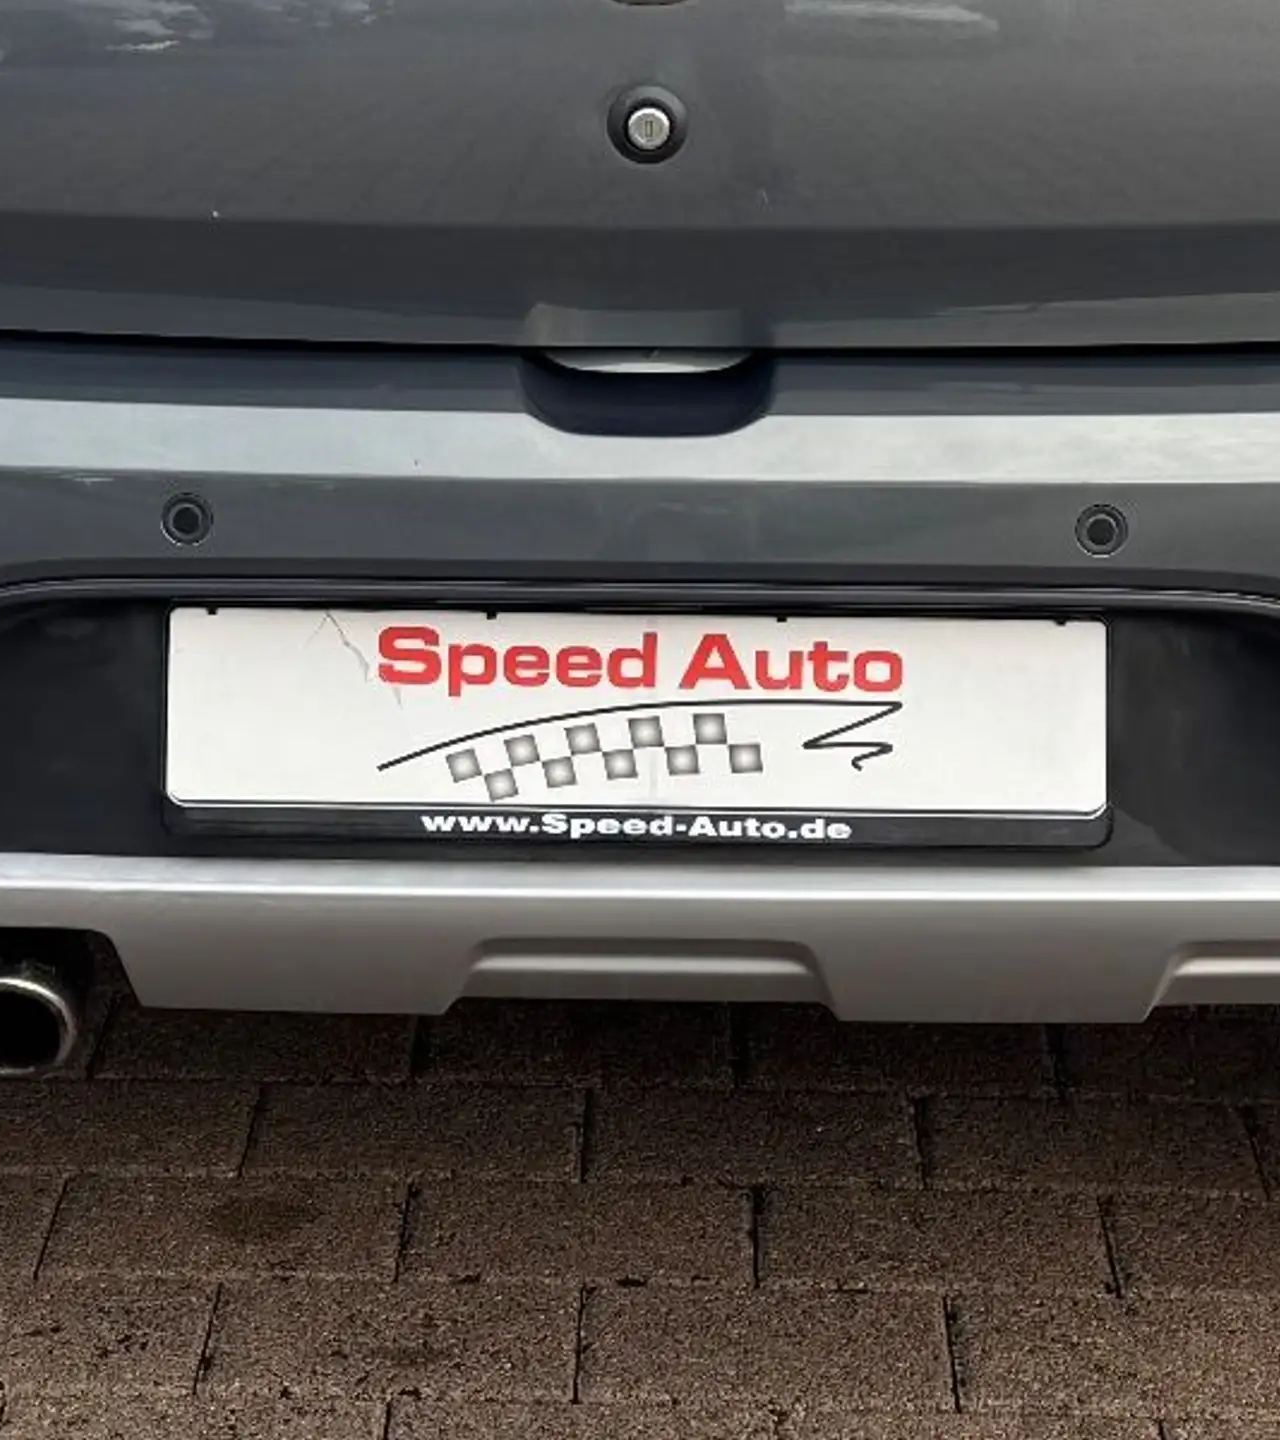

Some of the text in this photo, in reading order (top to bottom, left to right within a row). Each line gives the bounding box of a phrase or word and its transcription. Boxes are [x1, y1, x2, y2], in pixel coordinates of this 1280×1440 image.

[377, 625, 905, 698] Speed Auto
[419, 812, 853, 841] www.Speed-Auto.de
